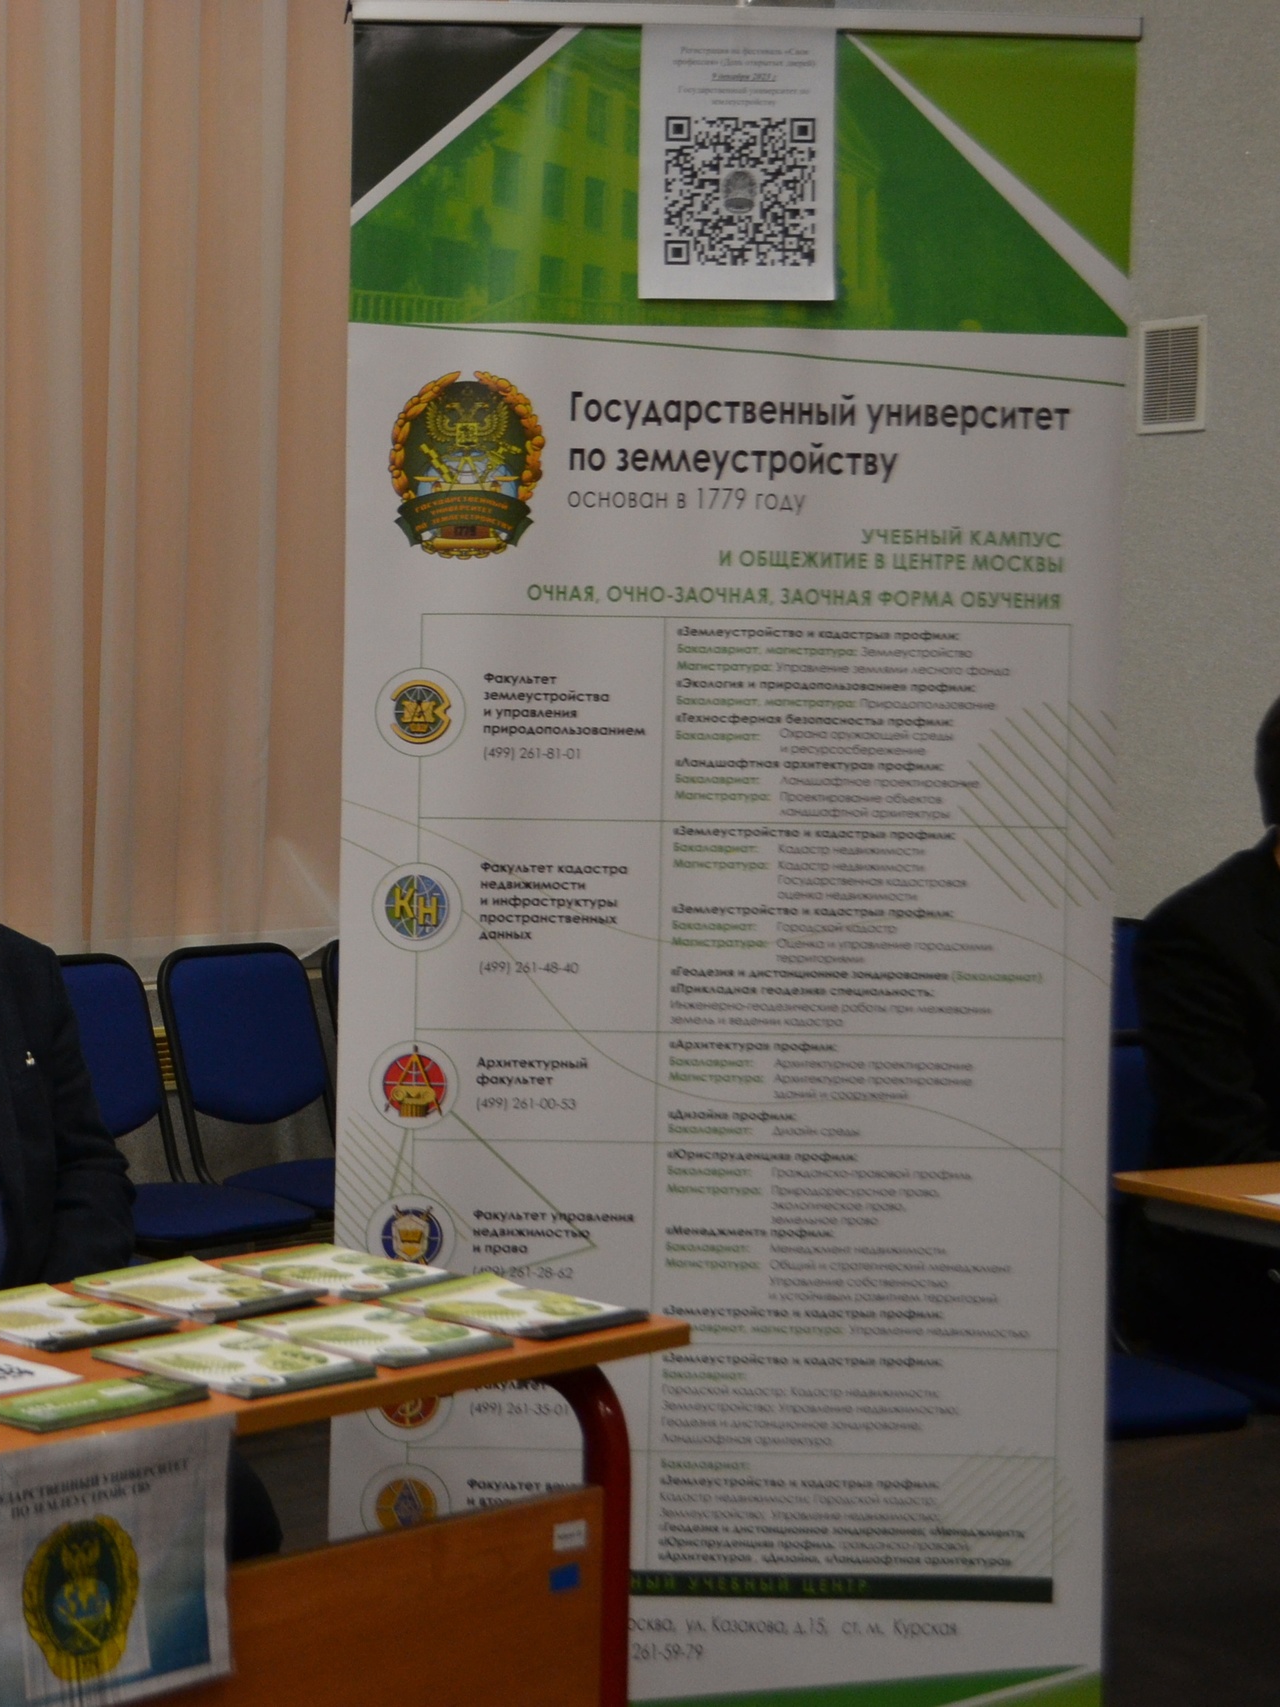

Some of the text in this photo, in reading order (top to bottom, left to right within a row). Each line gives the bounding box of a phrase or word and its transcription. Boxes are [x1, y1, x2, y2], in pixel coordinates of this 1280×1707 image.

[570, 391, 1071, 435] Государственный университет
[569, 442, 899, 483] по землеустройству
[567, 488, 806, 516] основан в 1779 году
[861, 526, 1062, 549] УЧЕБНЫЙ КАМПУС
[718, 549, 1065, 573] И ОБЩЕЖИТИЕ В ЦЕНТРЕ МОСКВЫ
[527, 584, 1061, 611] ОЧНАЯ, ОЧНО-ЗАОЧНАЯ, ЗАОЧНАЯ ФОРМА ОБУЧЕНИЯ
[677, 626, 959, 642] «Землеустройство и кадастры» профили:
[484, 672, 556, 685] Факультет
[676, 678, 976, 694] «Экология и природопользование» профили:
[484, 690, 610, 703] землеустройства
[484, 708, 577, 720] и управления
[676, 713, 953, 727] «Техносферная безопасность» профили:
[483, 724, 645, 737] природопользованием
[483, 747, 581, 760] (499) 261-81-01
[675, 756, 944, 773] «Ландшафтная архитектура» профили:
[673, 826, 956, 842] «Землеустройство и кадастры» профили:
[480, 862, 628, 876] Факультет кадастра
[480, 880, 586, 891] недвижимости
[480, 896, 618, 909] и инфраструктуры
[672, 904, 954, 920] «Землеустройство и кадастры» профили:
[480, 913, 618, 926] пространственных
[479, 930, 532, 941] данных
[479, 961, 579, 975] (499) 261-48-40
[476, 1056, 587, 1070] Архитектурный
[476, 1073, 553, 1086] факультет
[476, 1096, 576, 1110] (499) 261-00-53
[473, 1210, 634, 1223] Факультет управления
[473, 1226, 590, 1239] недвижимостью
[473, 1243, 528, 1255] и права
[628, 1617, 676, 1634] осква,
